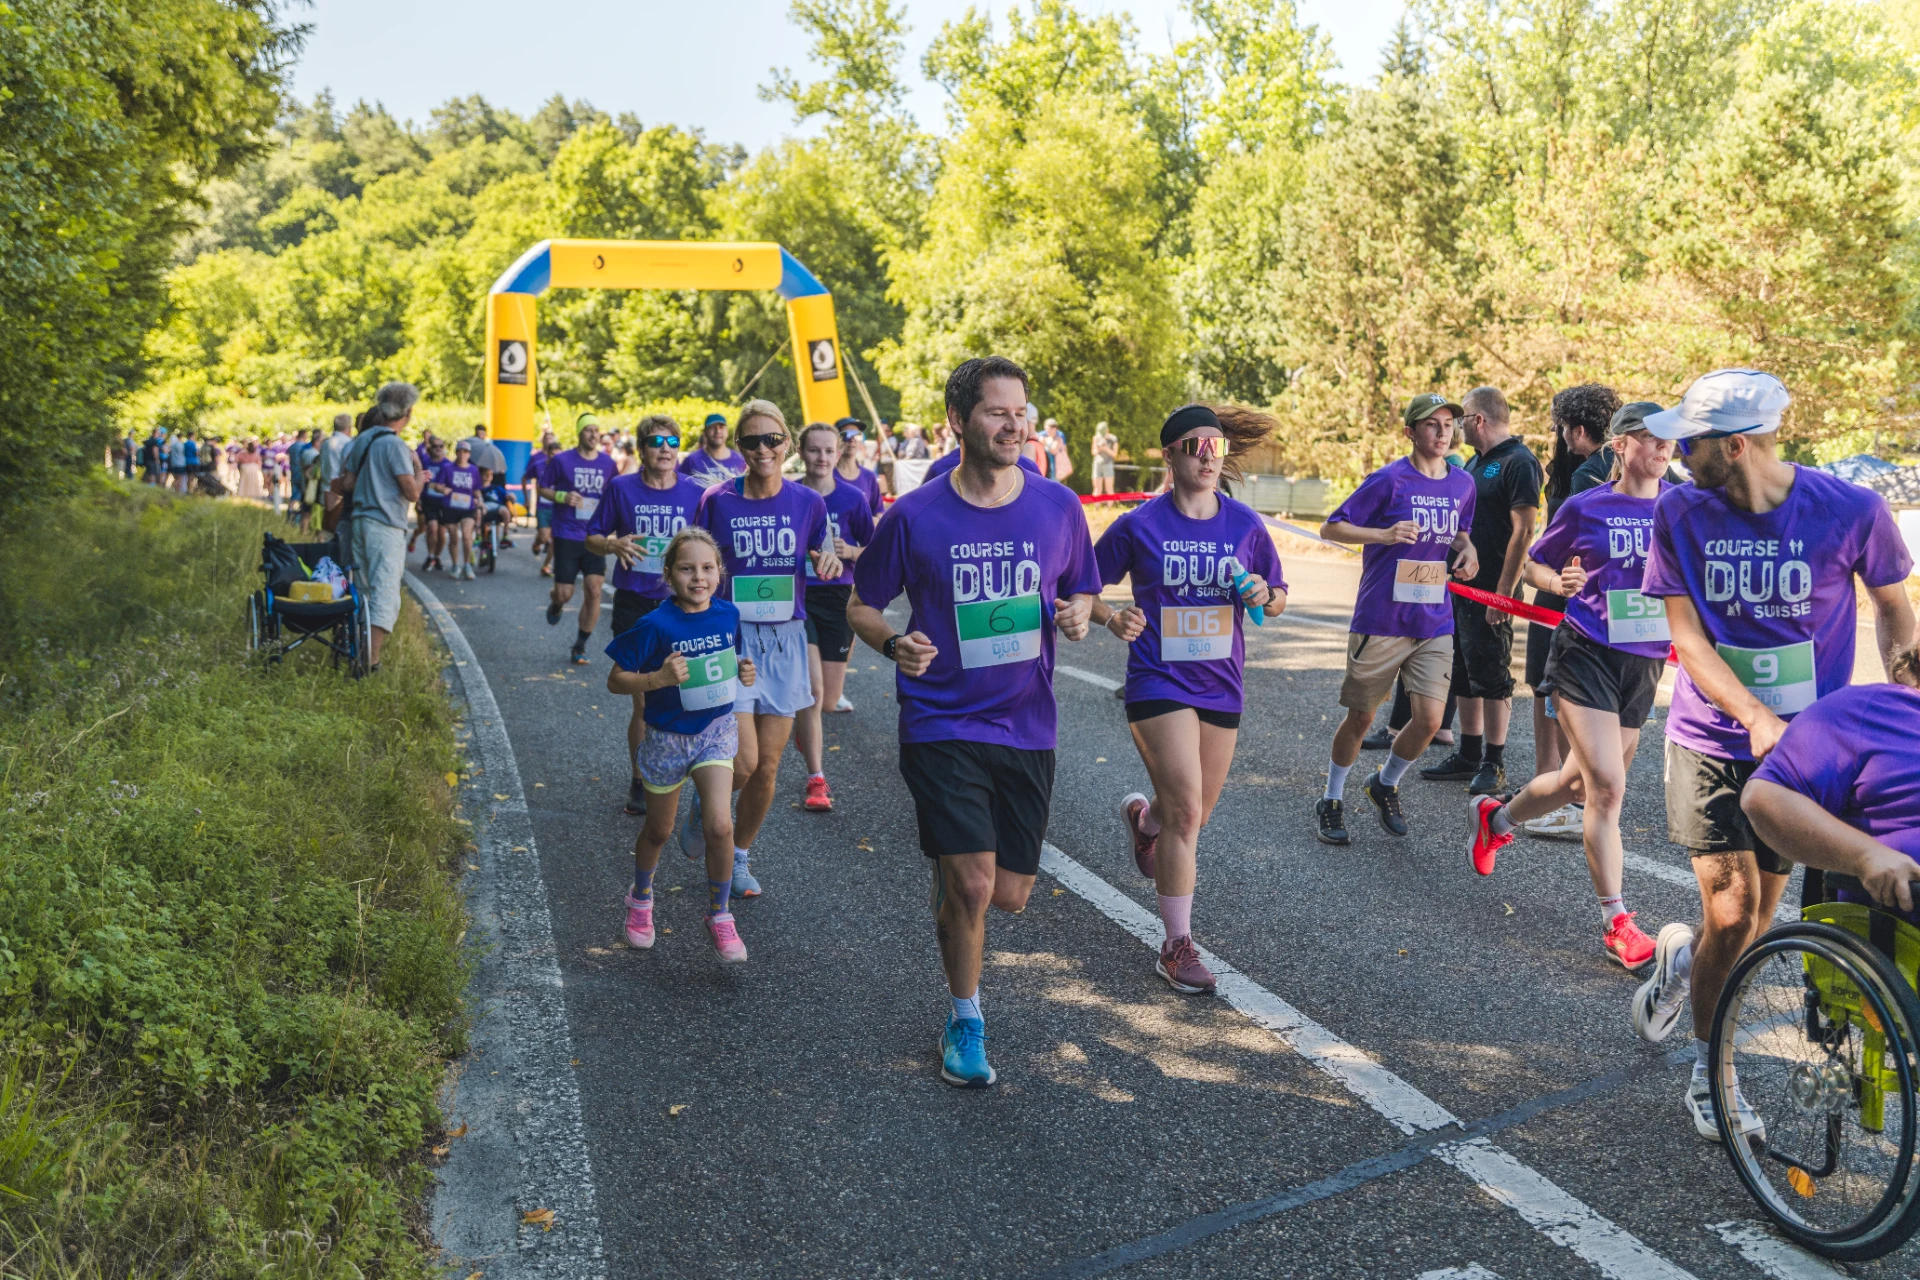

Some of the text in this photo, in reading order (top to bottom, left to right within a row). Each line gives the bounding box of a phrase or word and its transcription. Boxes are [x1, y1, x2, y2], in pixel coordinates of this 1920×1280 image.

[574, 473, 604, 489] DUO
[634, 505, 672, 514] COURSE
[1411, 495, 1450, 507] COURSE
[635, 515, 687, 538] DUO
[730, 515, 776, 528] COURSE
[1412, 507, 1459, 536] DUO
[646, 539, 671, 556] 67
[733, 528, 796, 558] DUO
[950, 541, 1015, 559] COURSE
[1163, 540, 1217, 553] COURSE
[1608, 528, 1653, 558] DU
[1705, 540, 1779, 557] COURSE
[762, 557, 795, 567] SUISSE
[1163, 554, 1235, 589] DUO
[953, 560, 1041, 602] DUO
[1408, 564, 1439, 583] 124
[1705, 560, 1812, 603] DUO
[757, 579, 774, 598] 6
[1626, 593, 1662, 617] 59
[1754, 602, 1811, 619] SUISSE
[989, 603, 1014, 633] 6
[1176, 610, 1220, 635] 106
[671, 634, 722, 653] COURSE
[992, 640, 1020, 655] DUO
[1188, 642, 1211, 653] DUO
[705, 657, 723, 681] 6
[1752, 653, 1779, 684] 9
